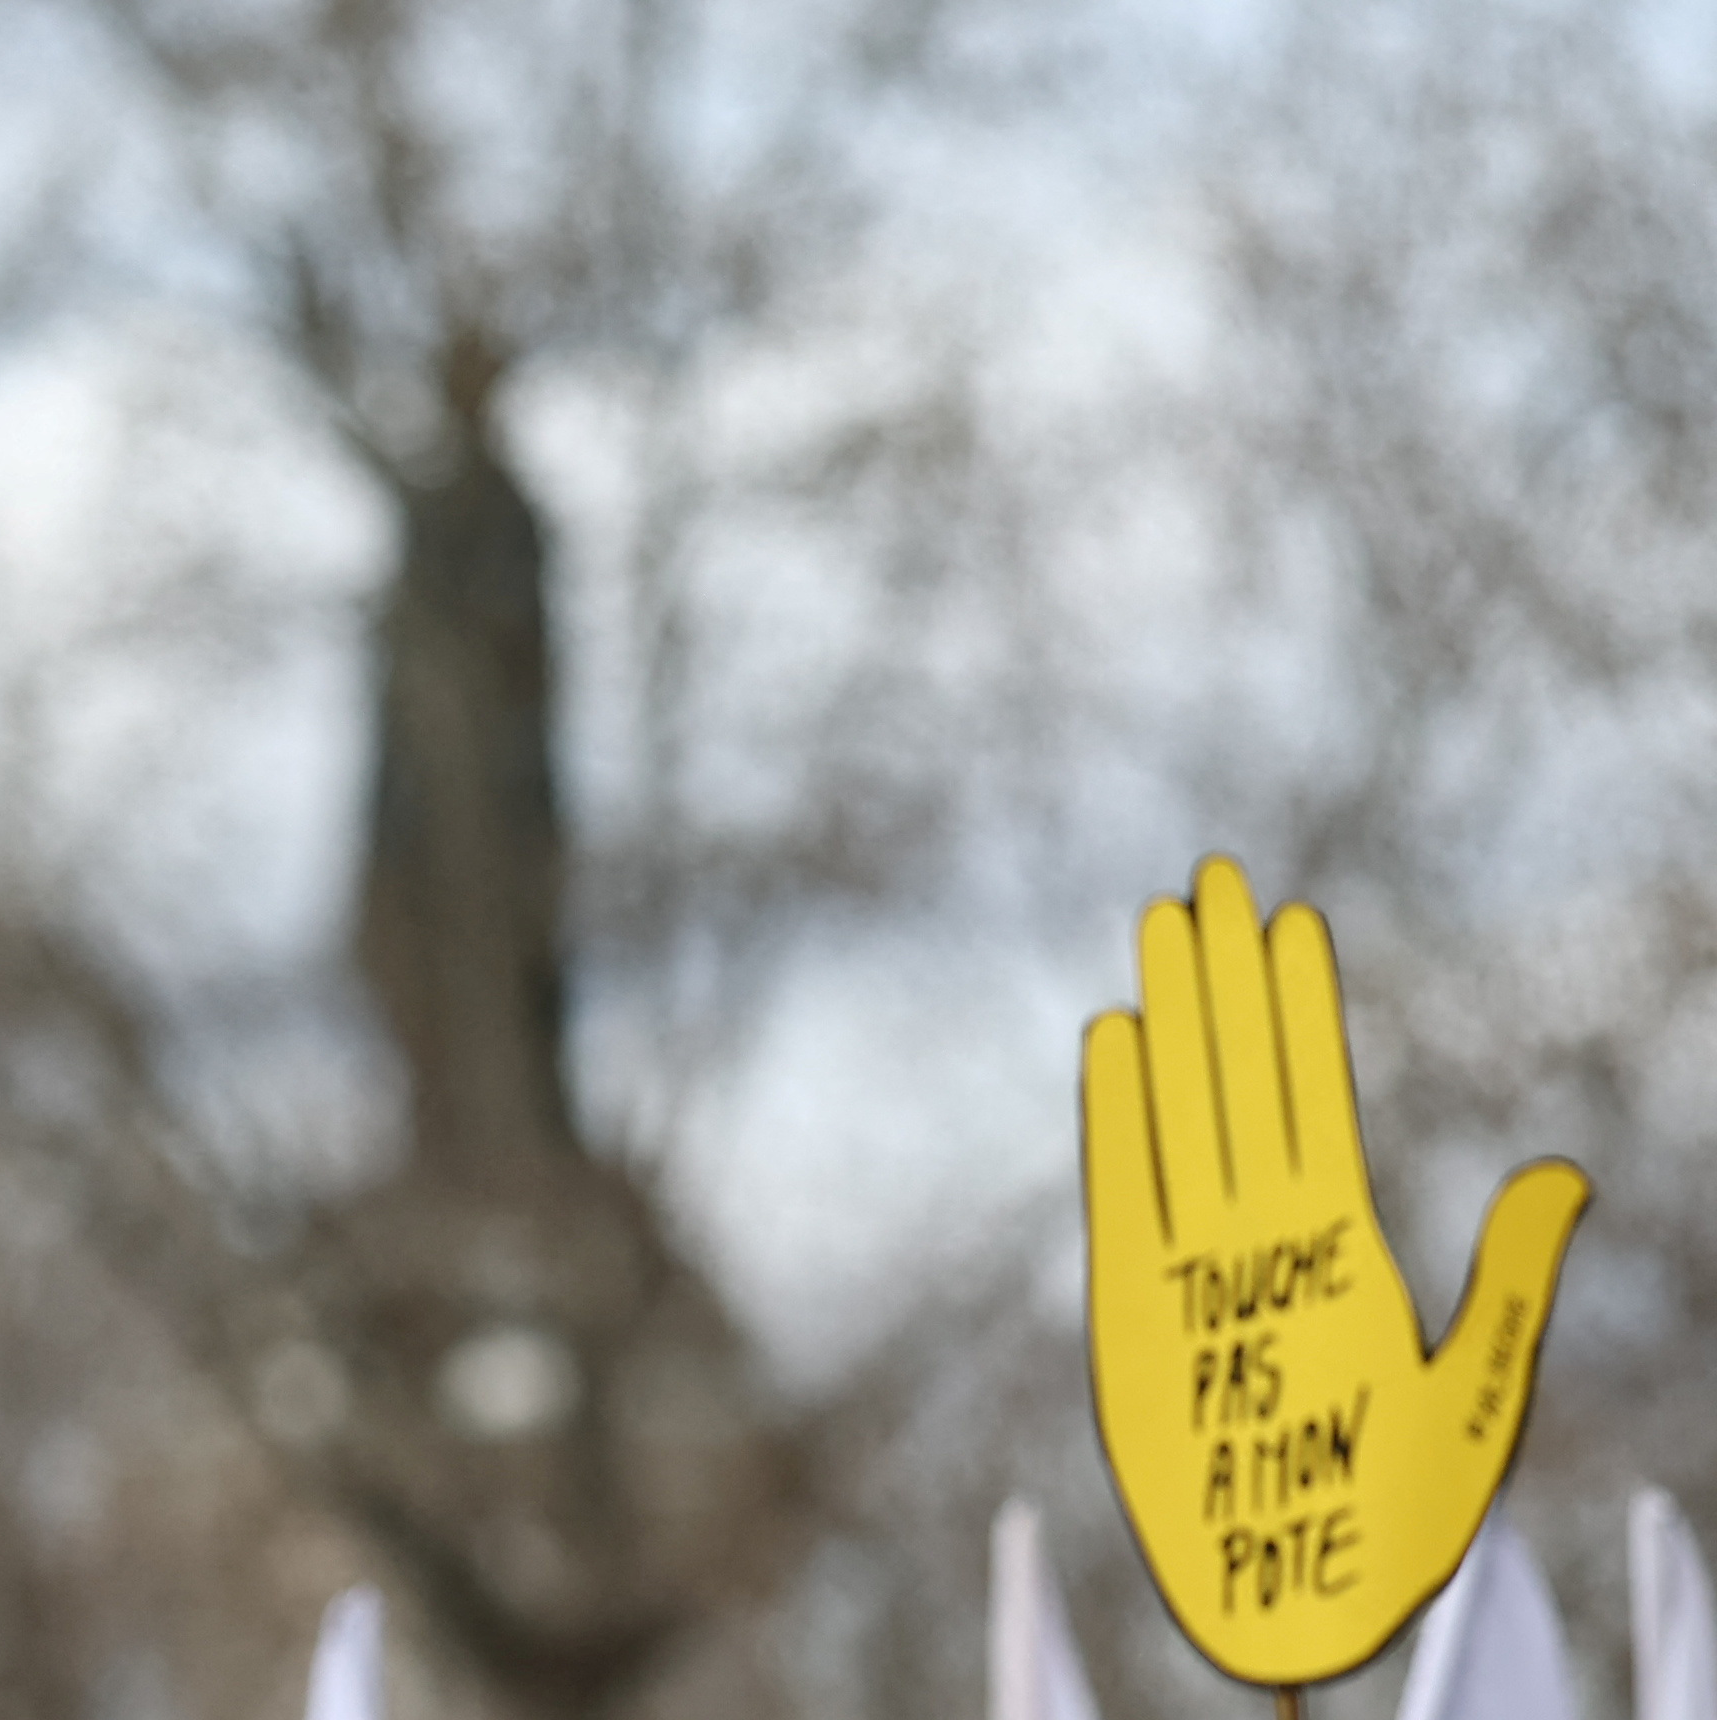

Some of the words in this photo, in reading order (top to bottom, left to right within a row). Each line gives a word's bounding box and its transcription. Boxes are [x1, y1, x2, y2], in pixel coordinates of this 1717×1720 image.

[1163, 1215, 1355, 1338] TOUCHE
[1189, 1332, 1285, 1434] PAS
[1218, 1506, 1362, 1619] POTE
